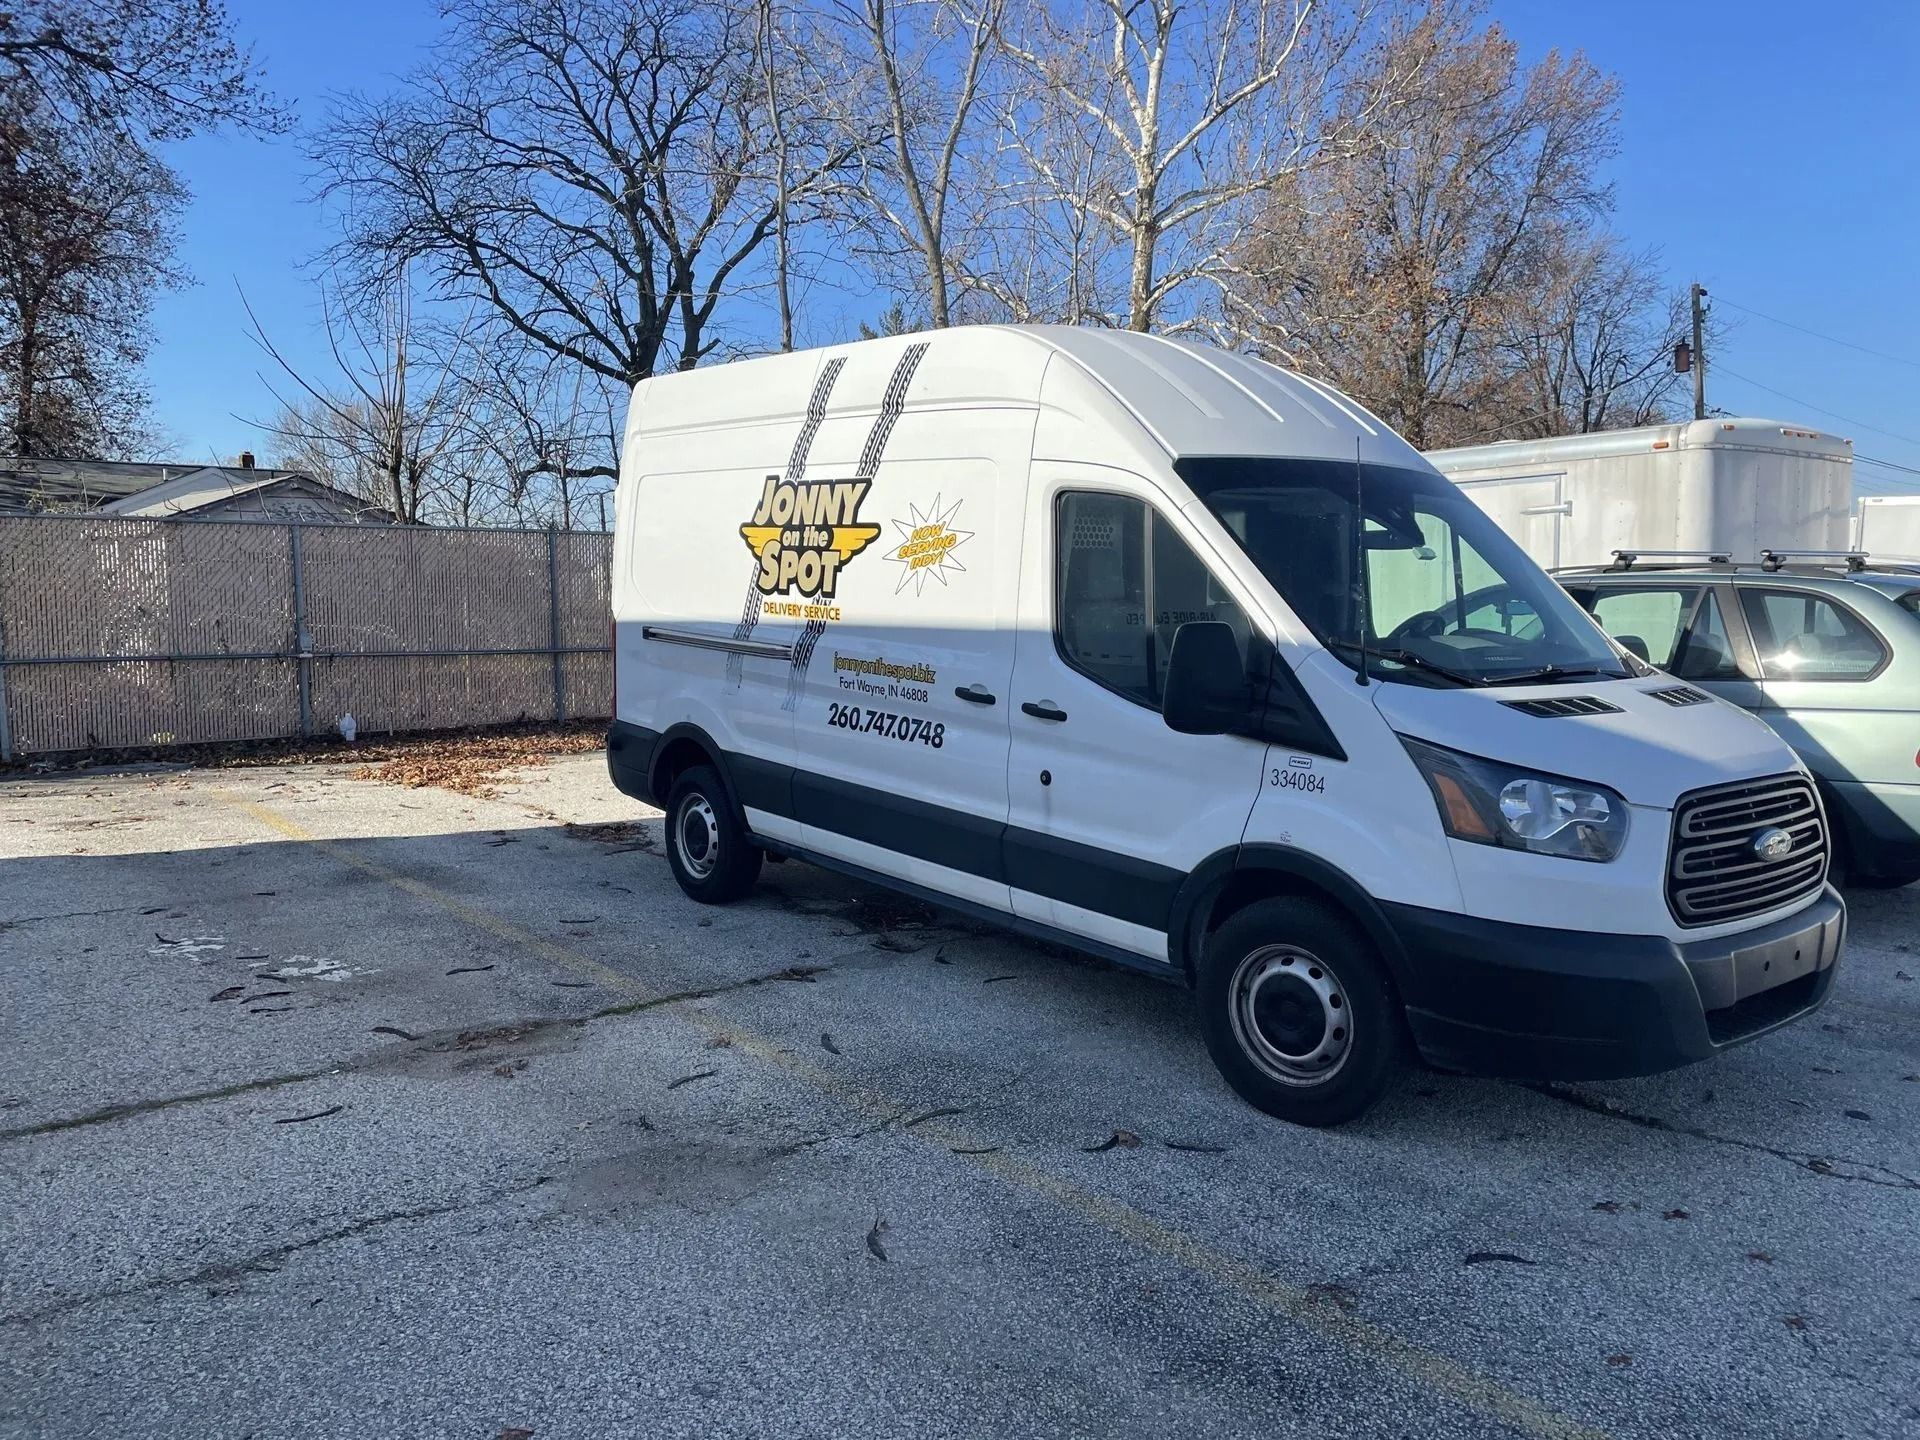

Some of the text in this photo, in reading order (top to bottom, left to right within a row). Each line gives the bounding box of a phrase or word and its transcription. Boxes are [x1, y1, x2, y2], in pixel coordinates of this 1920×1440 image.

[752, 476, 871, 527] JONNY
[782, 526, 829, 547] on the
[910, 521, 946, 543] NOW
[897, 533, 957, 559] SERVING
[756, 540, 841, 597] SPOT
[910, 548, 946, 571] INDY!
[763, 602, 840, 620] DELIVERY SERVICE
[833, 651, 936, 684] jonnyonthespot.biz
[839, 677, 928, 702] Fort Wayne, IN 46808
[828, 703, 945, 748] 260.747.0748
[1271, 768, 1325, 794] 334084
